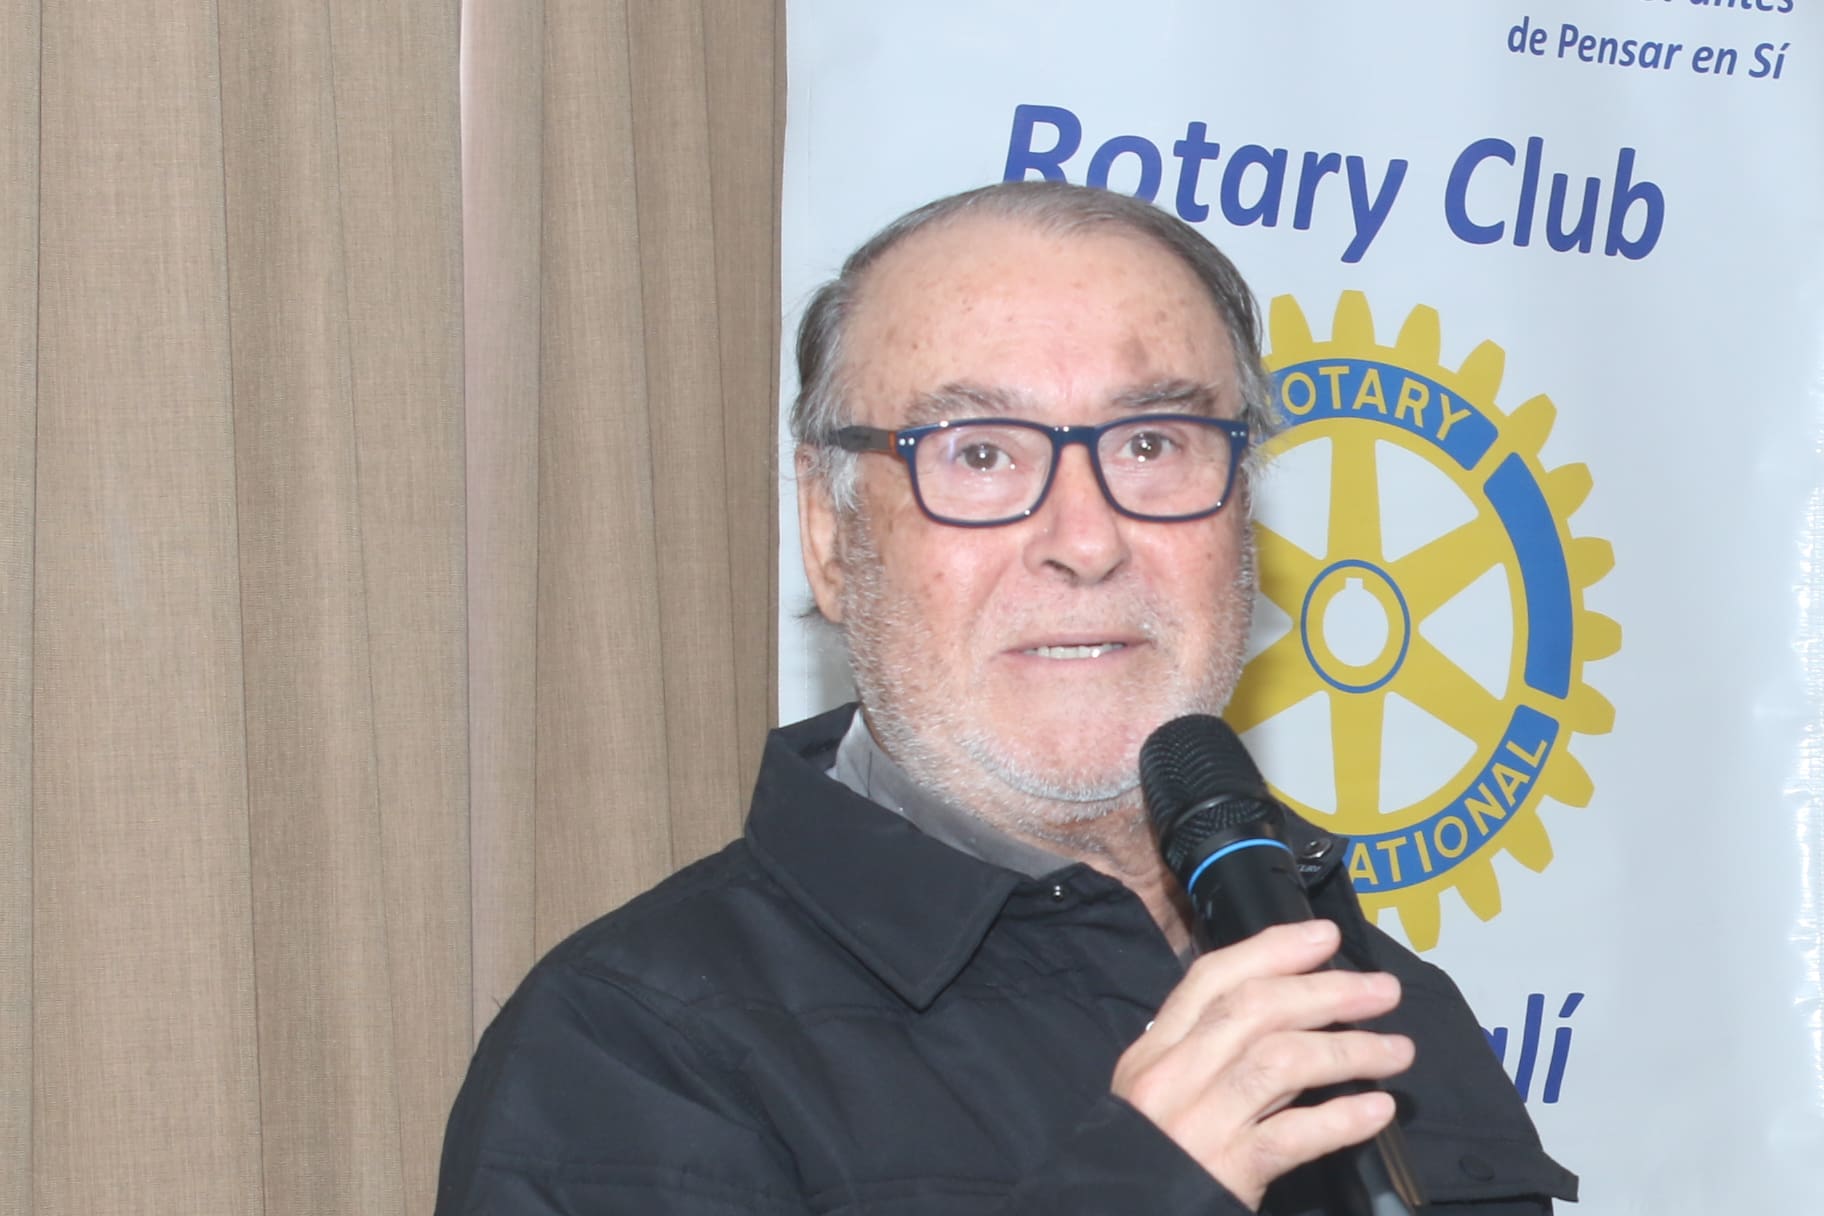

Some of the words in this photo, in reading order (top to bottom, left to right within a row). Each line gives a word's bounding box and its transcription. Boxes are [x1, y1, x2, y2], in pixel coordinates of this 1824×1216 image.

[1506, 15, 1548, 56] de
[1557, 23, 1683, 71] Pensar
[1691, 44, 1738, 76] en
[1748, 42, 1791, 80] Sí
[1002, 103, 1408, 263] Rotary
[1444, 136, 1665, 260] Club
[1266, 365, 1473, 442] OTARY
[1349, 739, 1548, 885] ATIONAL
